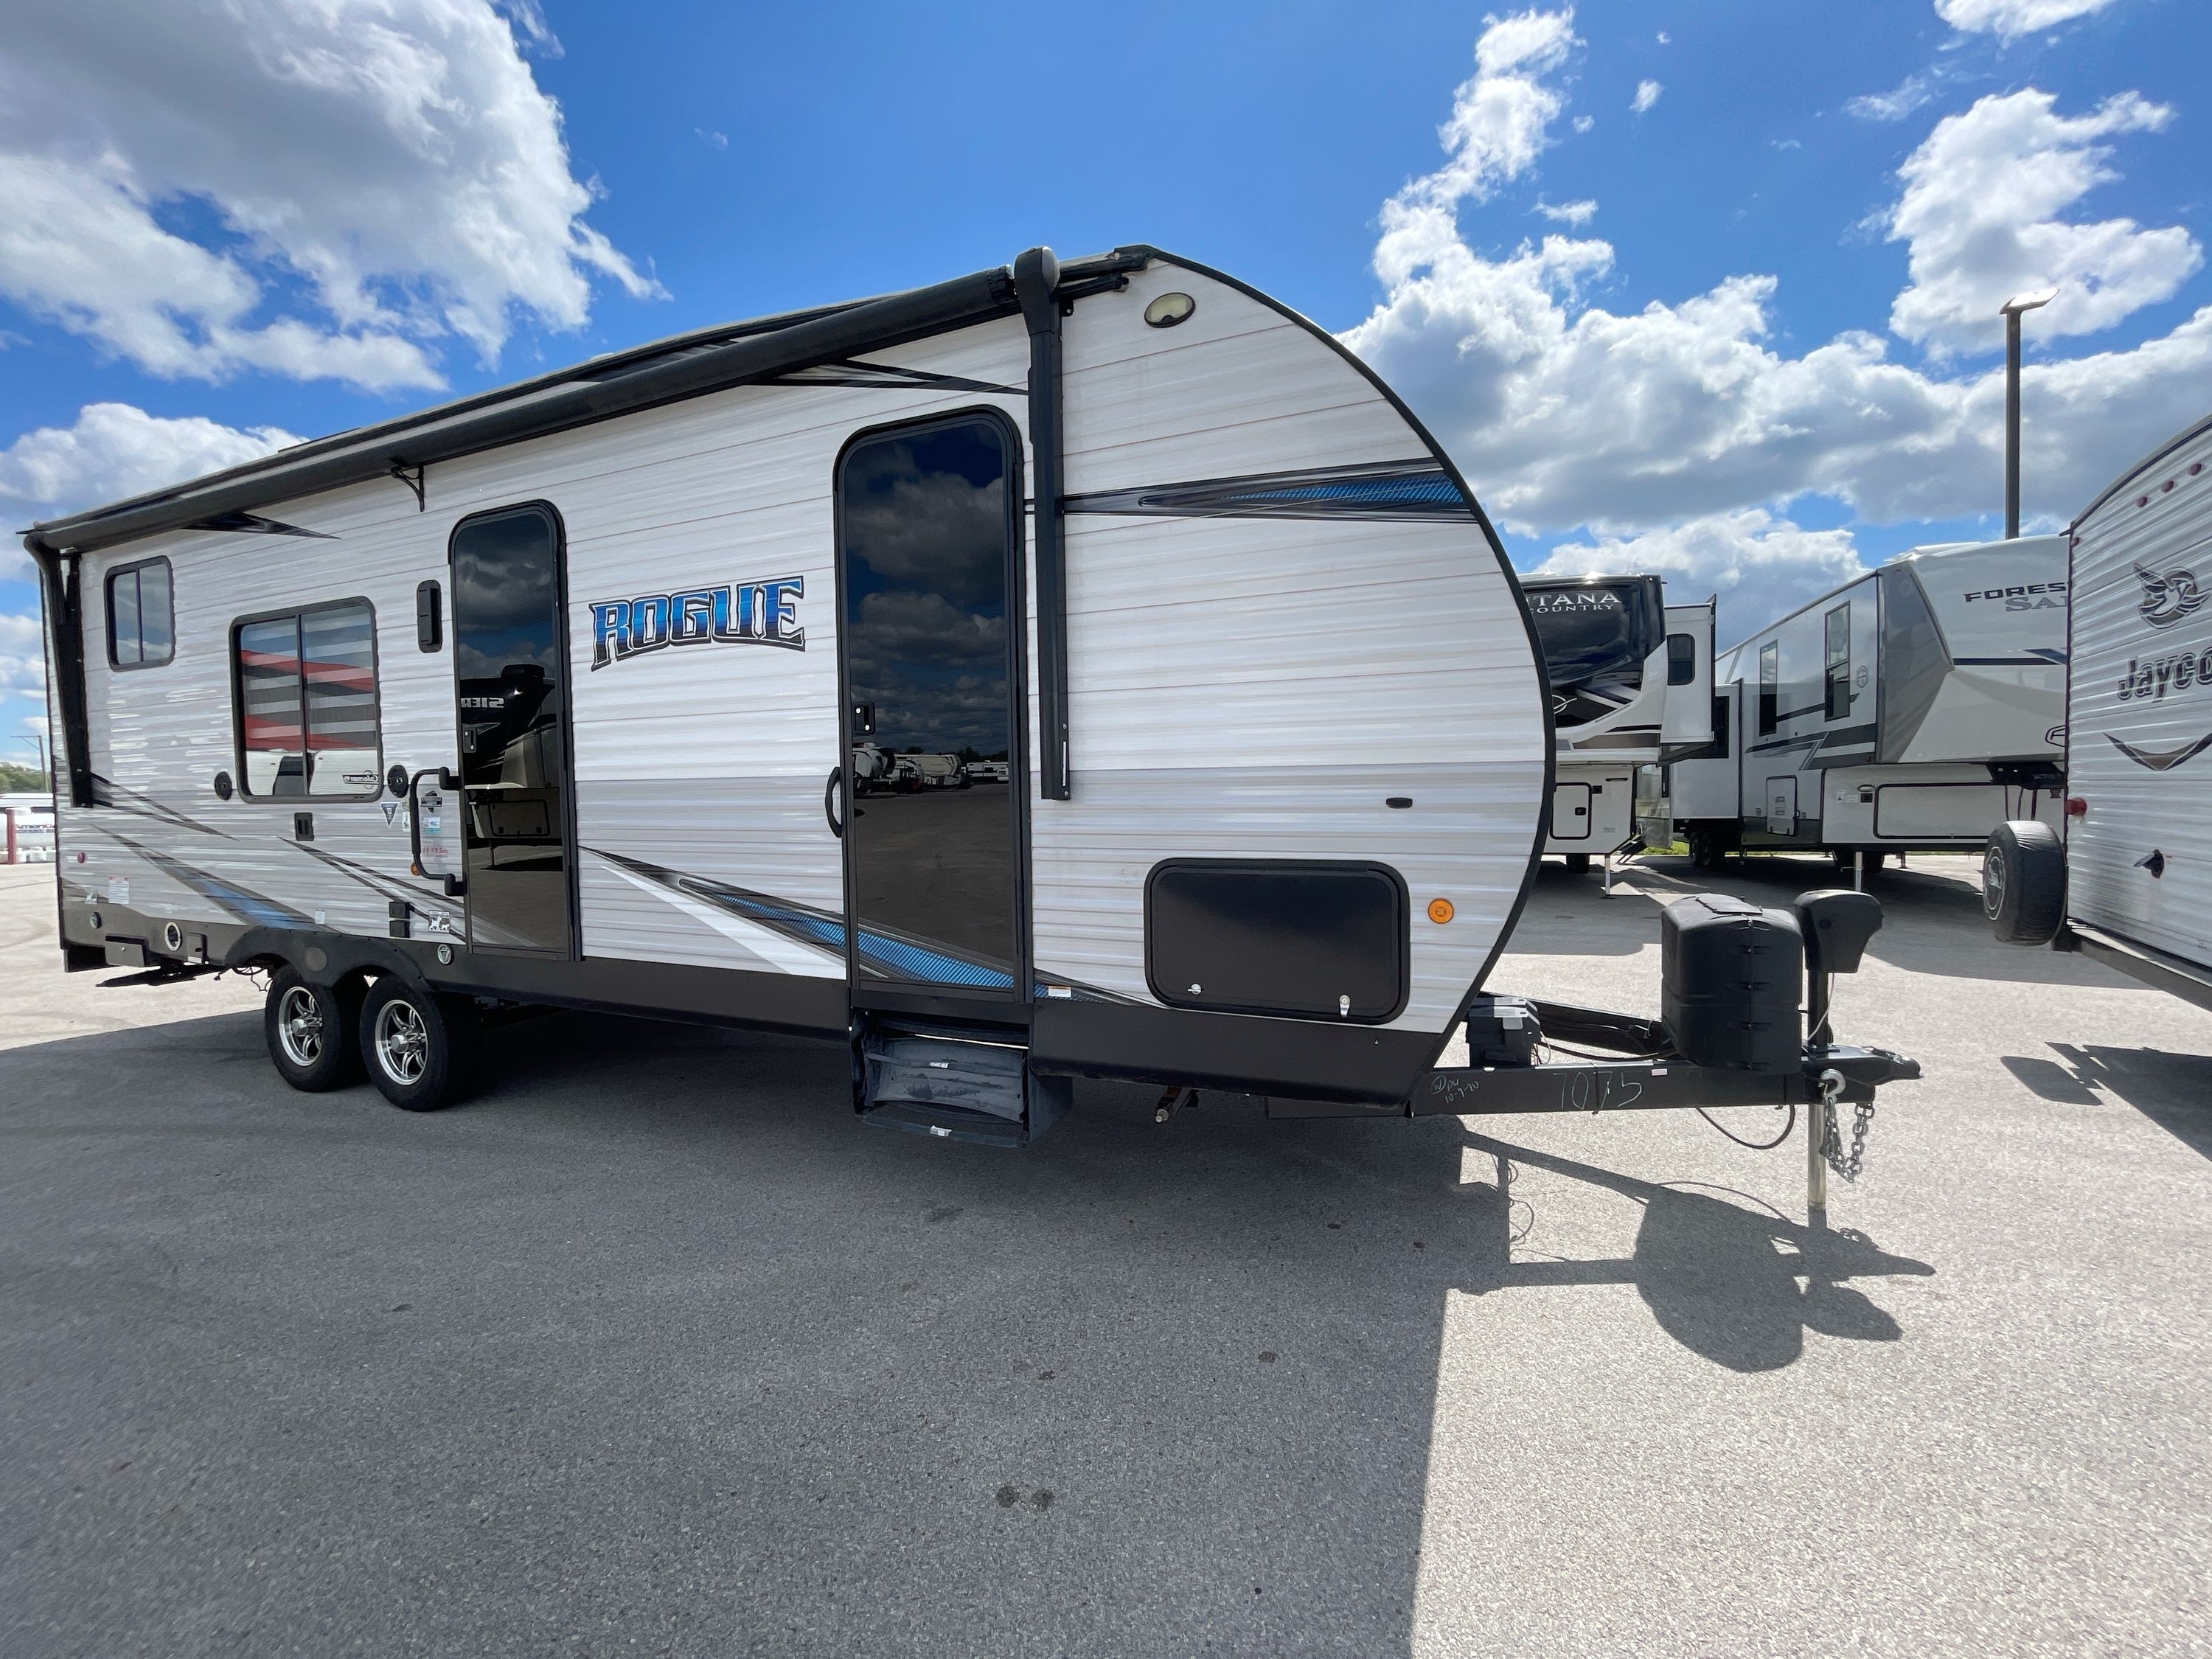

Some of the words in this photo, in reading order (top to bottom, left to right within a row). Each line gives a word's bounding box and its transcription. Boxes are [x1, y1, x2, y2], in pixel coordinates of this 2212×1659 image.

[1963, 582, 2068, 602] FORES
[589, 575, 806, 672] ROGUE
[2117, 646, 2212, 703] Jayco
